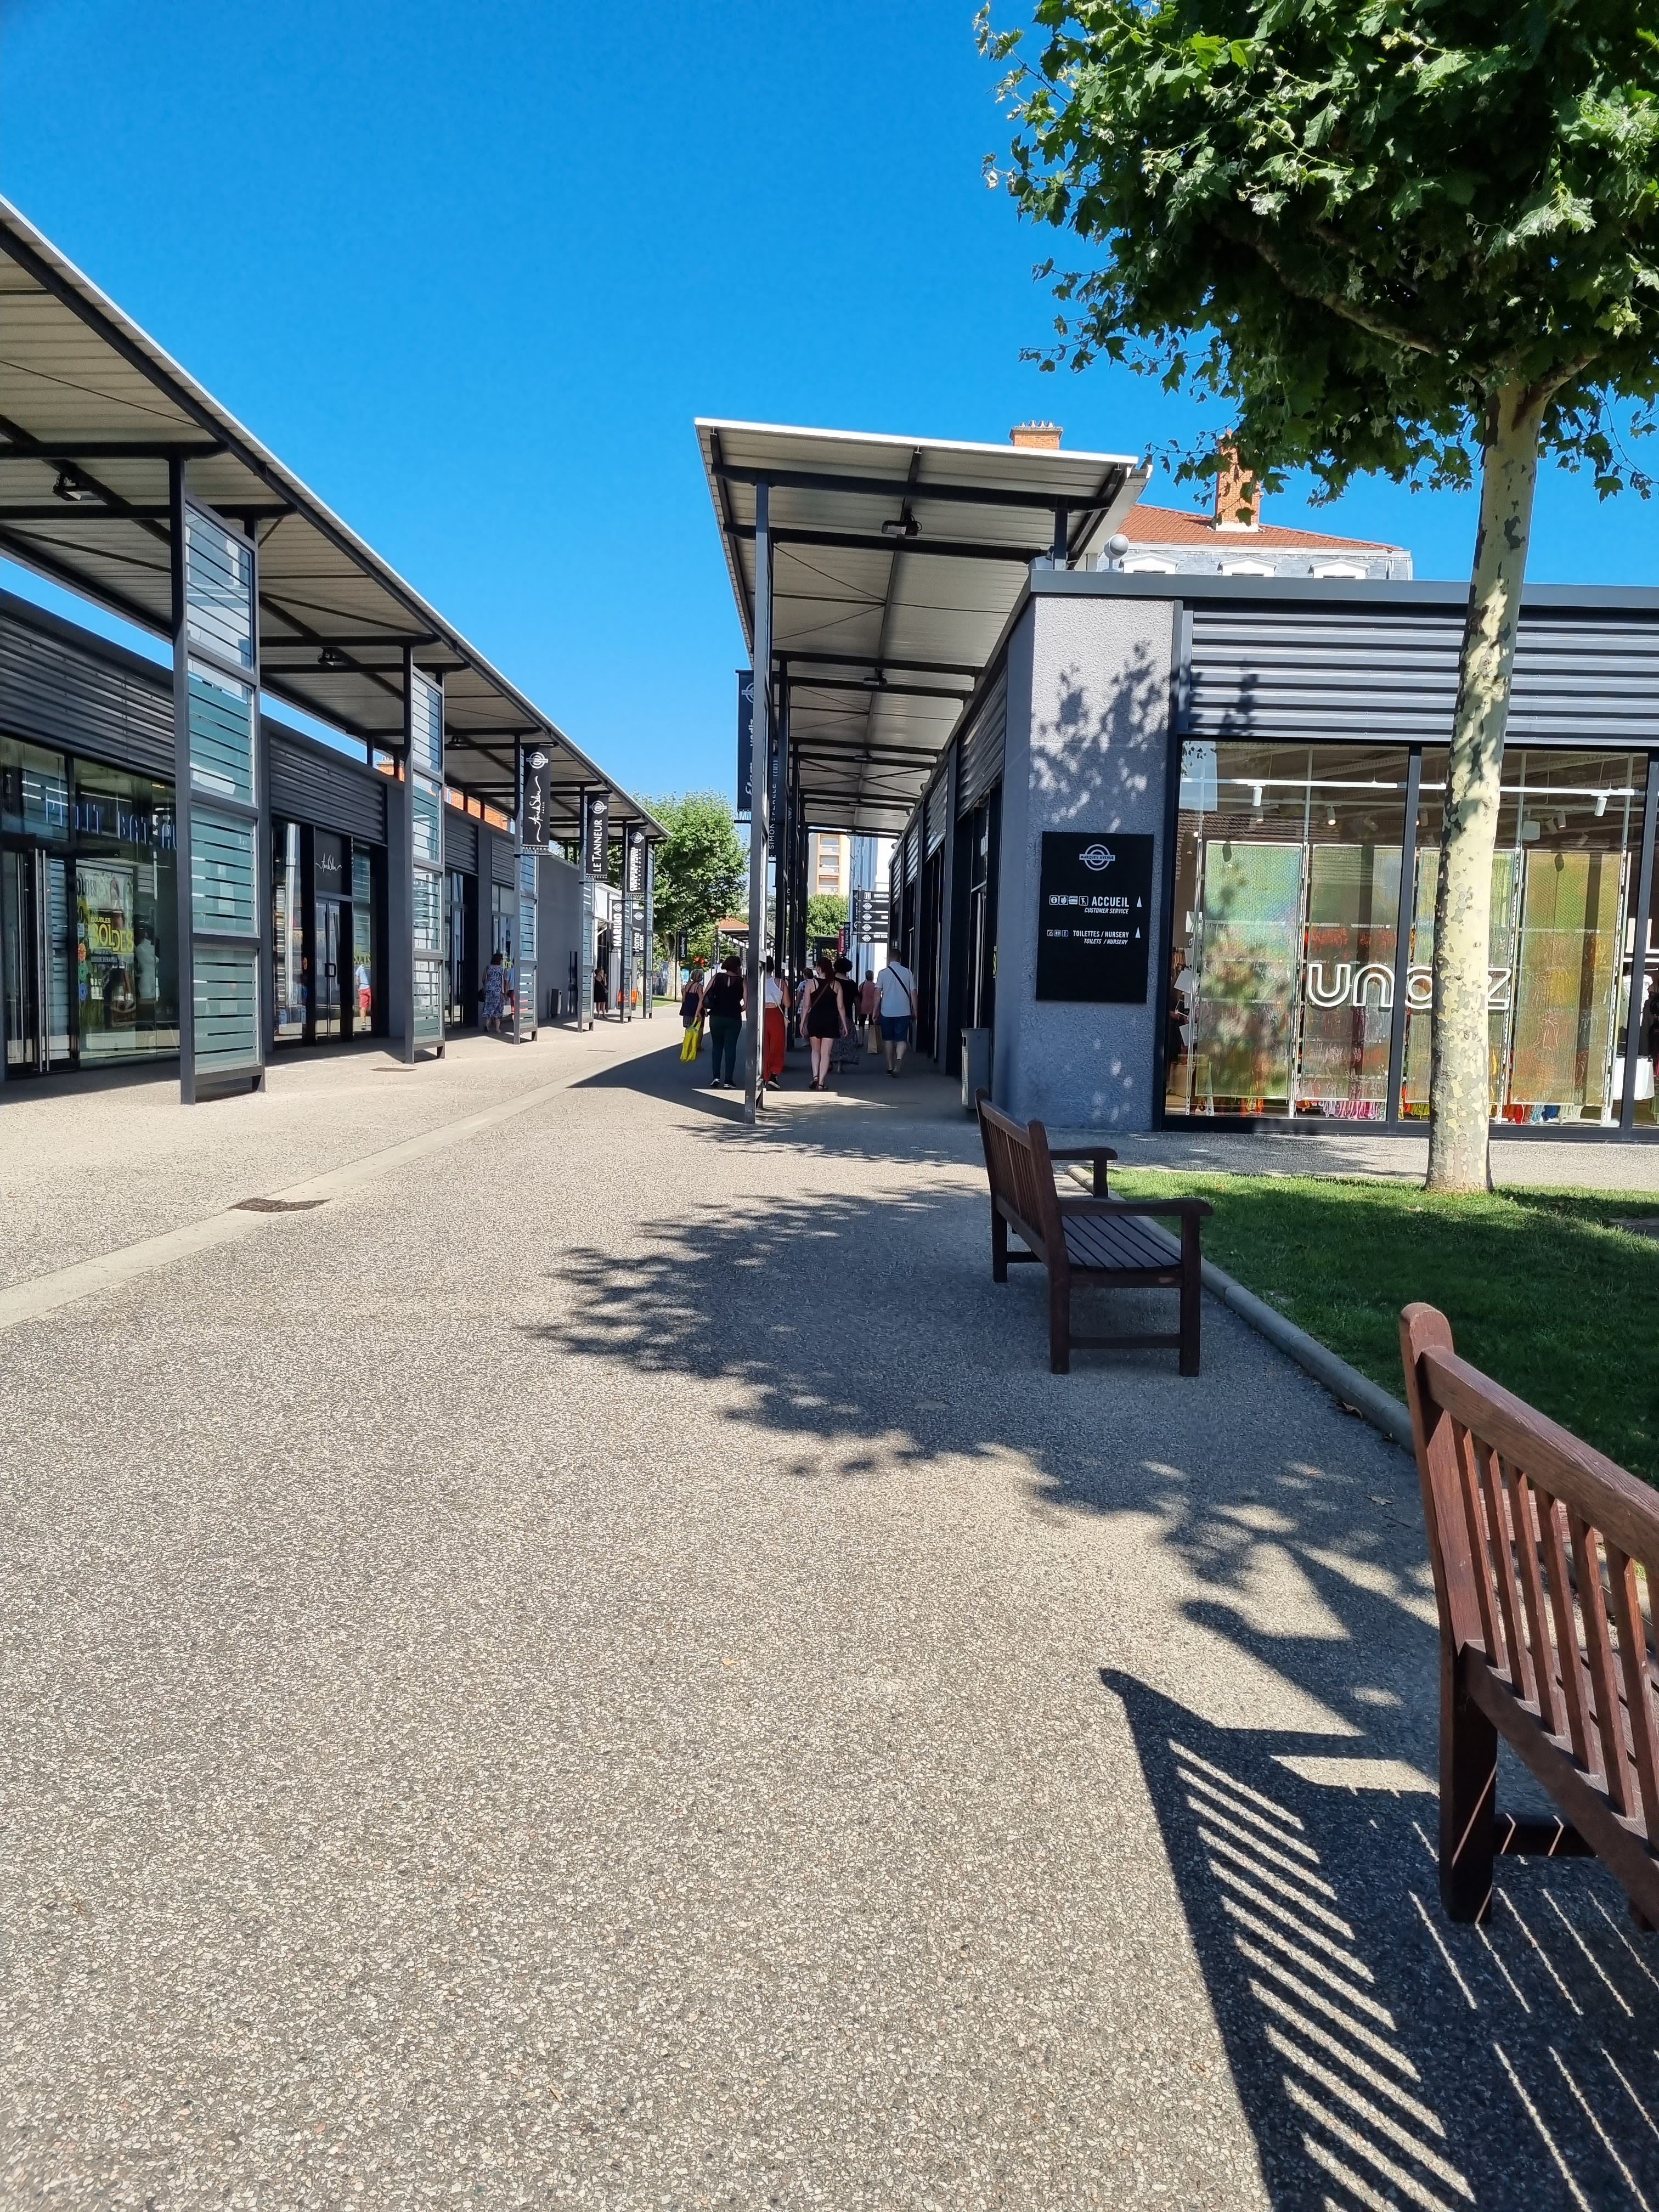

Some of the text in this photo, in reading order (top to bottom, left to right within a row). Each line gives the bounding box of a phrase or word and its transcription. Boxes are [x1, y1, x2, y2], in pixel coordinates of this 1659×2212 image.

[592, 820, 602, 872] LE TANNEUR
[1091, 896, 1130, 907] ACCUEIL
[1307, 963, 1512, 1011] unz
